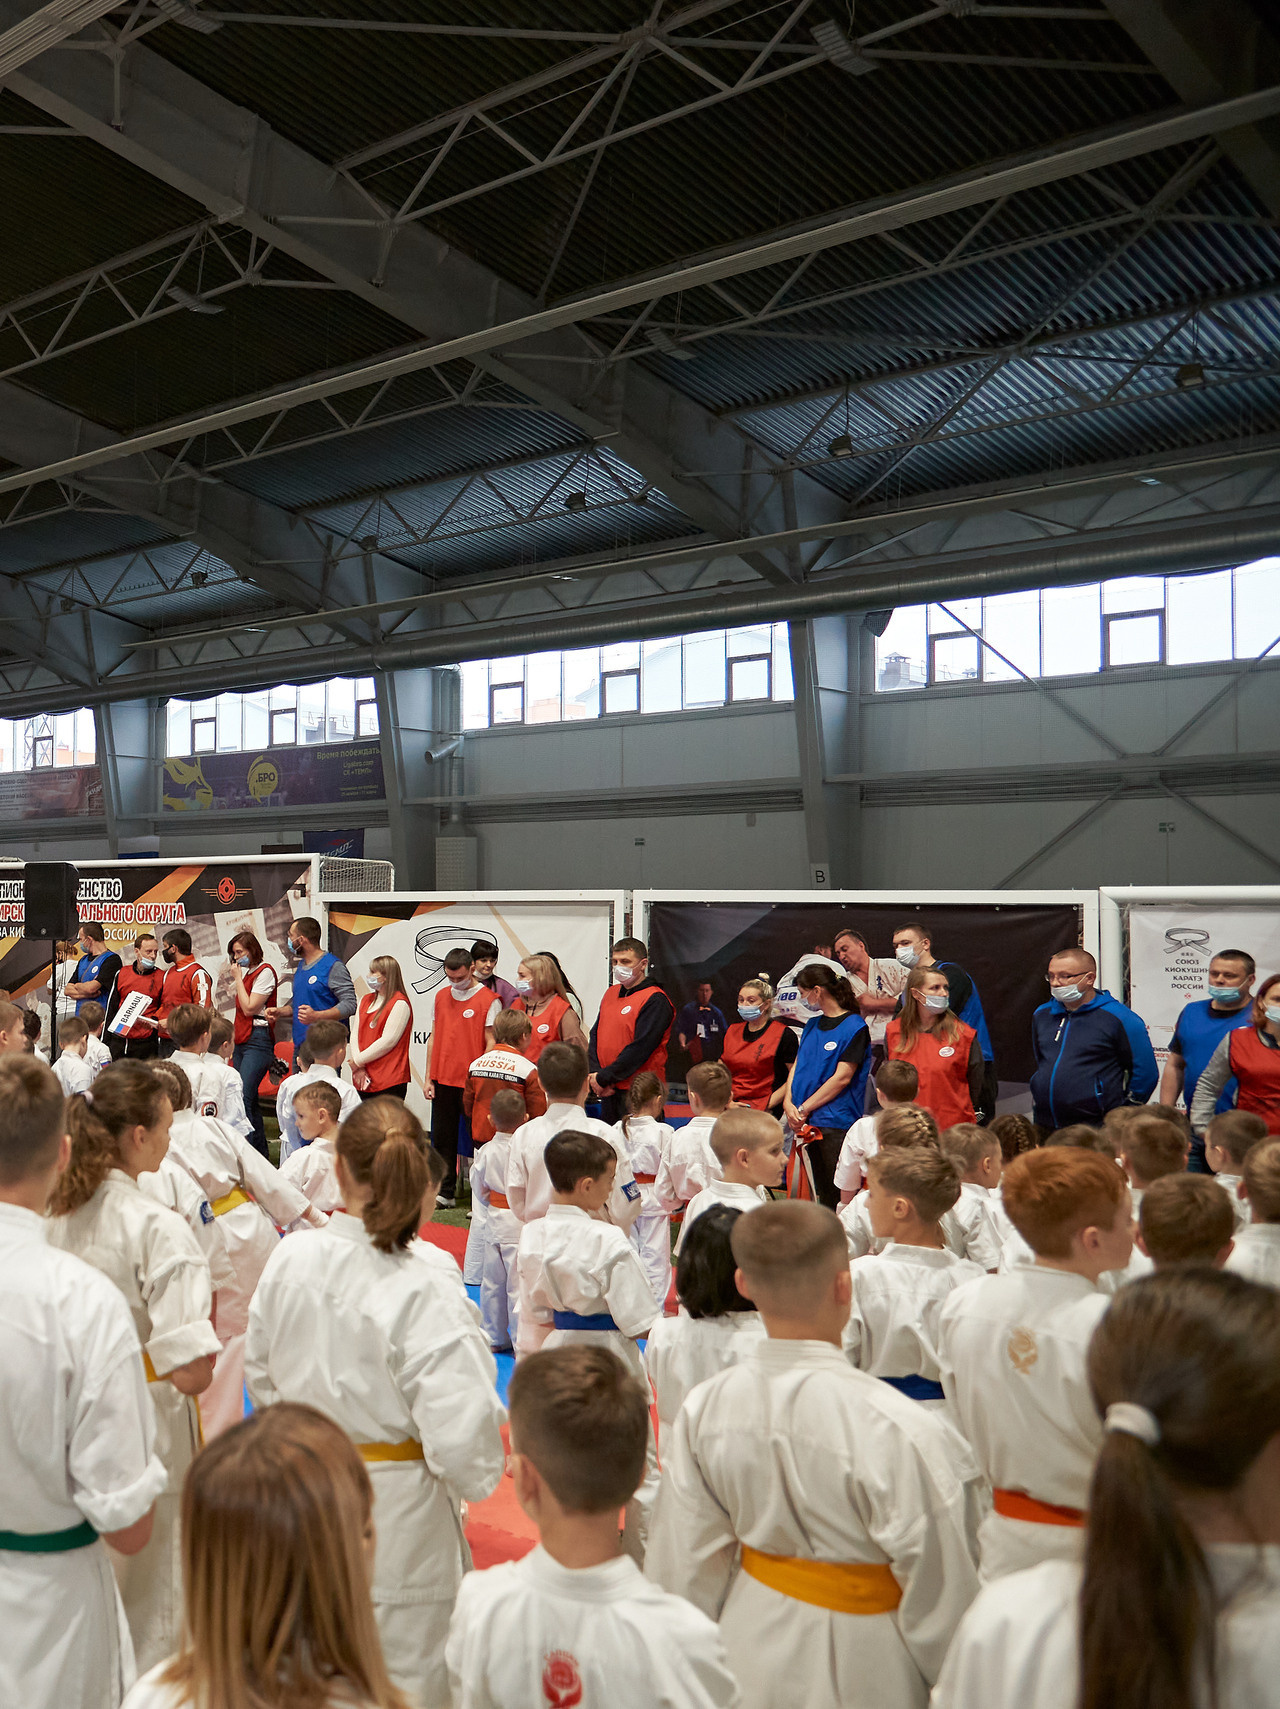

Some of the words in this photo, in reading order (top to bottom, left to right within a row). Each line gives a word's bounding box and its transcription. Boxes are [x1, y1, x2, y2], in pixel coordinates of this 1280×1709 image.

[317, 751, 339, 760] Время
[135, 902, 186, 924] ОКРУГА
[121, 996, 143, 1023] BARNAUL
[476, 1059, 516, 1072] RUSSIA
